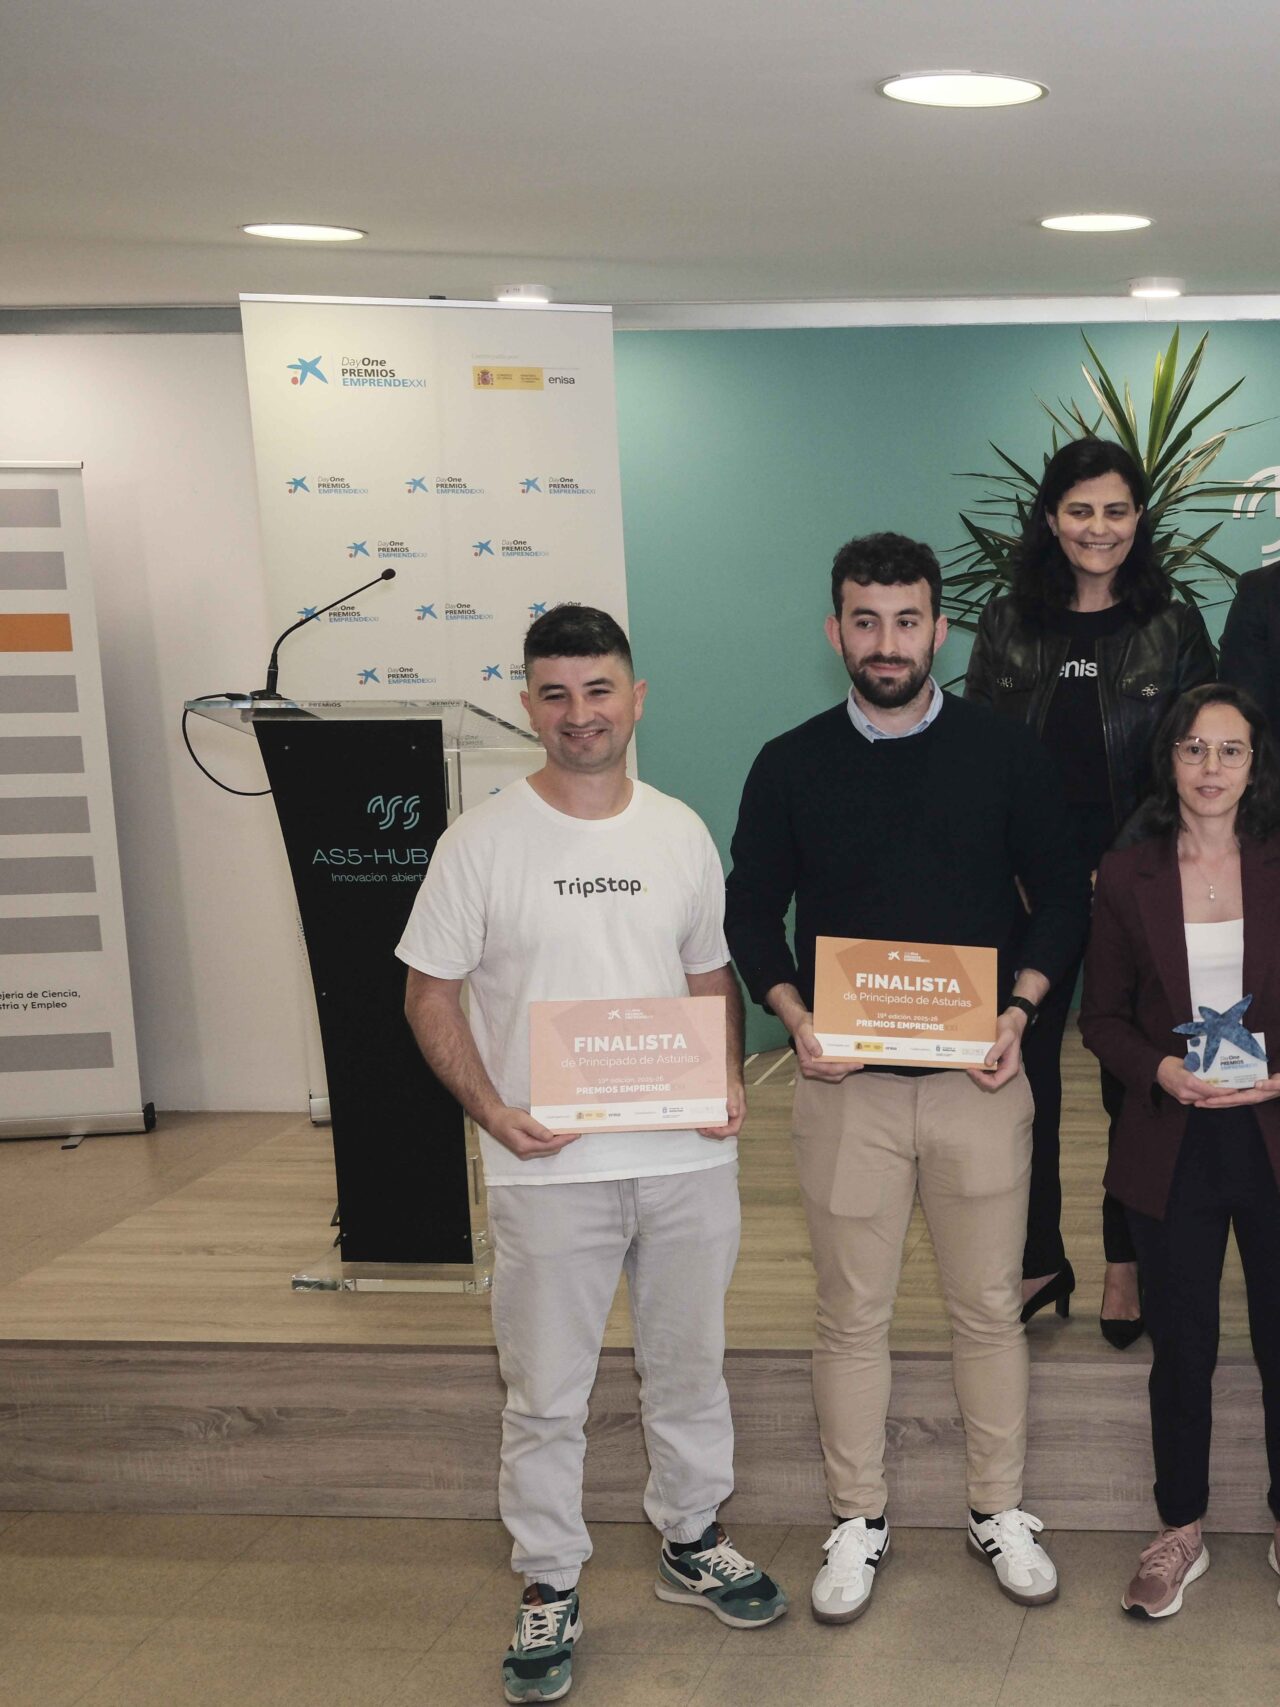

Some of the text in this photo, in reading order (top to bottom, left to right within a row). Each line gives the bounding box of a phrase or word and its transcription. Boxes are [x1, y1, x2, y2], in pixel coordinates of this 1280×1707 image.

[341, 368, 396, 378] PREMIOS
[342, 377, 427, 388] EMPRENDEXXI
[548, 376, 575, 385] enisa
[312, 848, 429, 865] AS5-HUB
[856, 973, 961, 994] FINALISTA
[42, 990, 81, 998] Ciencia,
[844, 992, 972, 1007] de Principado de Asturias
[31, 1002, 68, 1010] Empleo
[856, 1020, 896, 1028] PREMIOS
[574, 1033, 688, 1053] FINALISTA
[561, 1054, 700, 1068] de Principado de Asturias
[576, 1086, 618, 1095] PREMIOS
